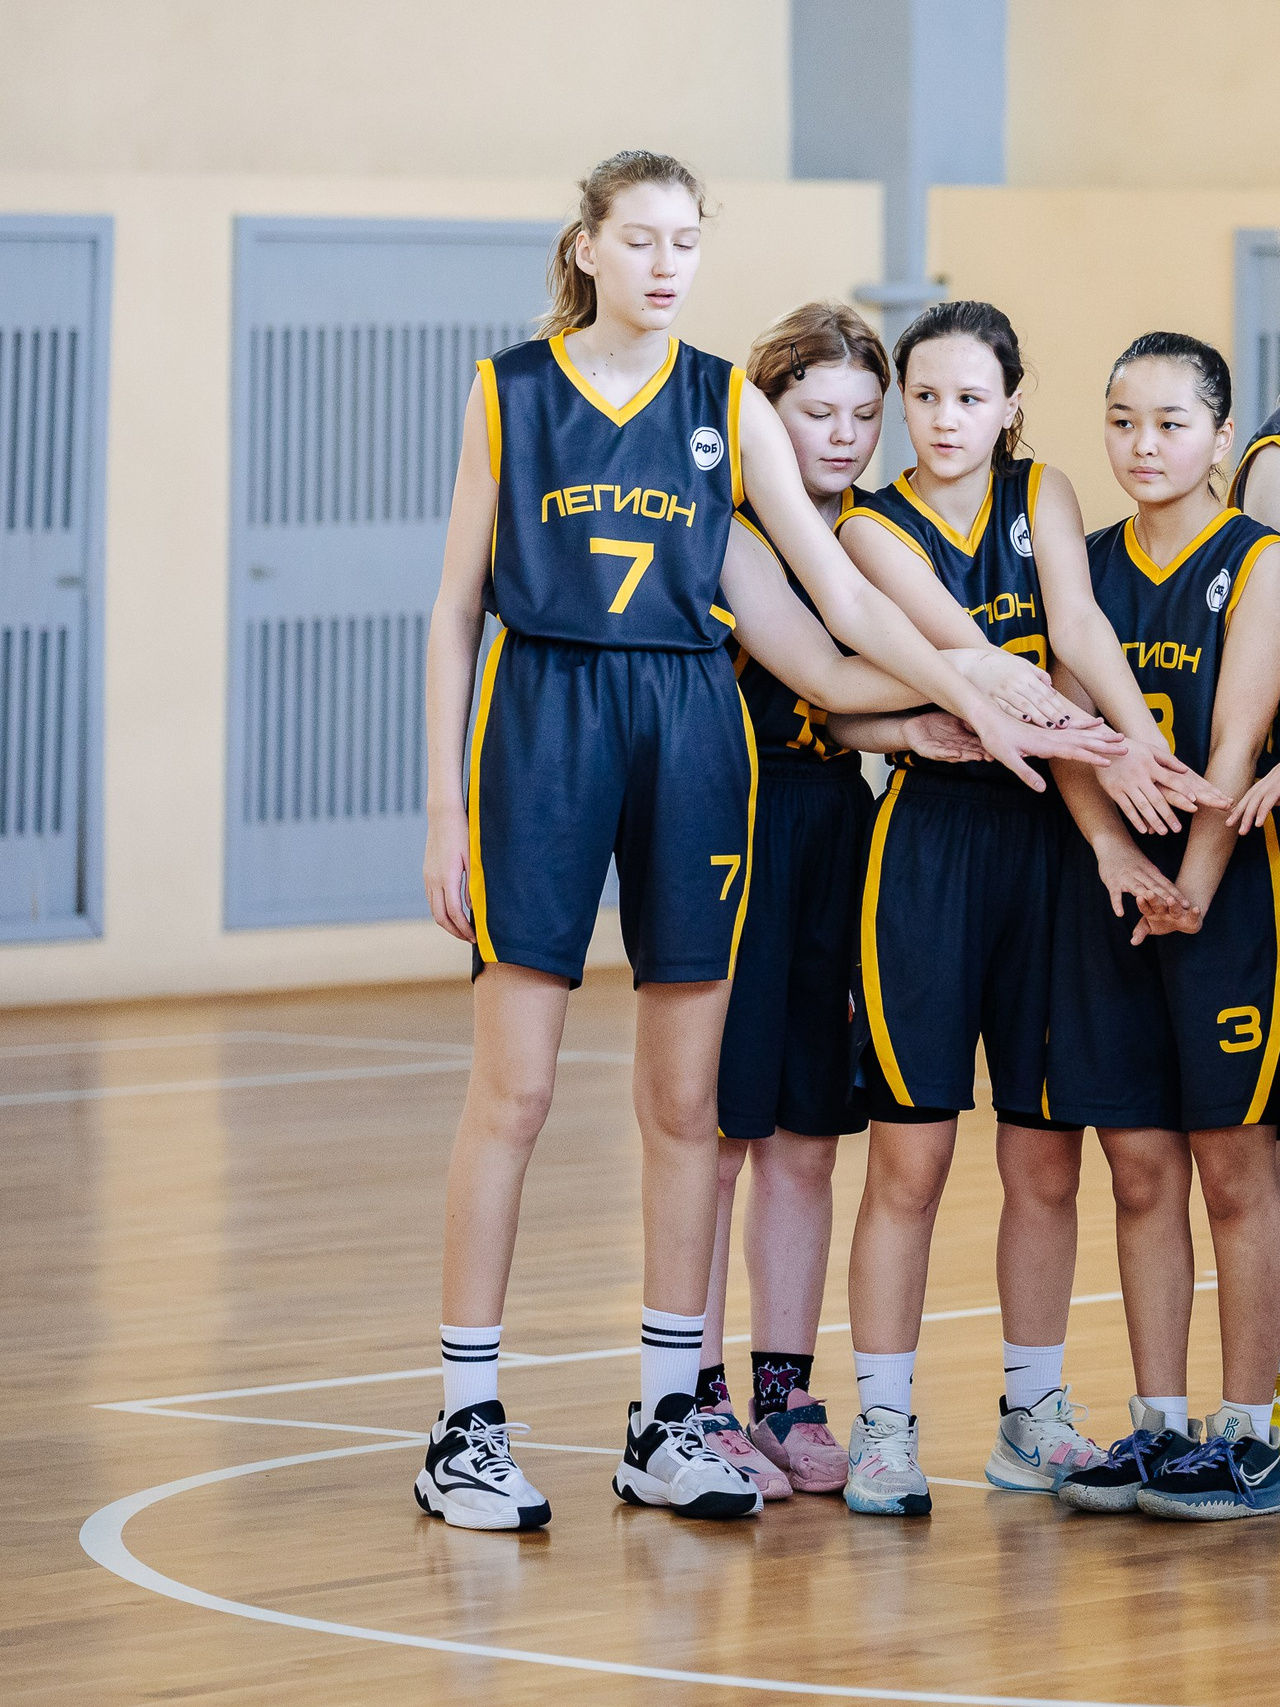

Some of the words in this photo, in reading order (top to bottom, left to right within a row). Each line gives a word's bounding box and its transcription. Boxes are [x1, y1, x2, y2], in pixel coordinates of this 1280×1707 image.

[695, 442, 718, 454] РФБ
[541, 484, 697, 528] ЛЕГИОН
[589, 537, 655, 614] 7
[710, 855, 741, 900] 7
[1217, 1005, 1263, 1054] 3
